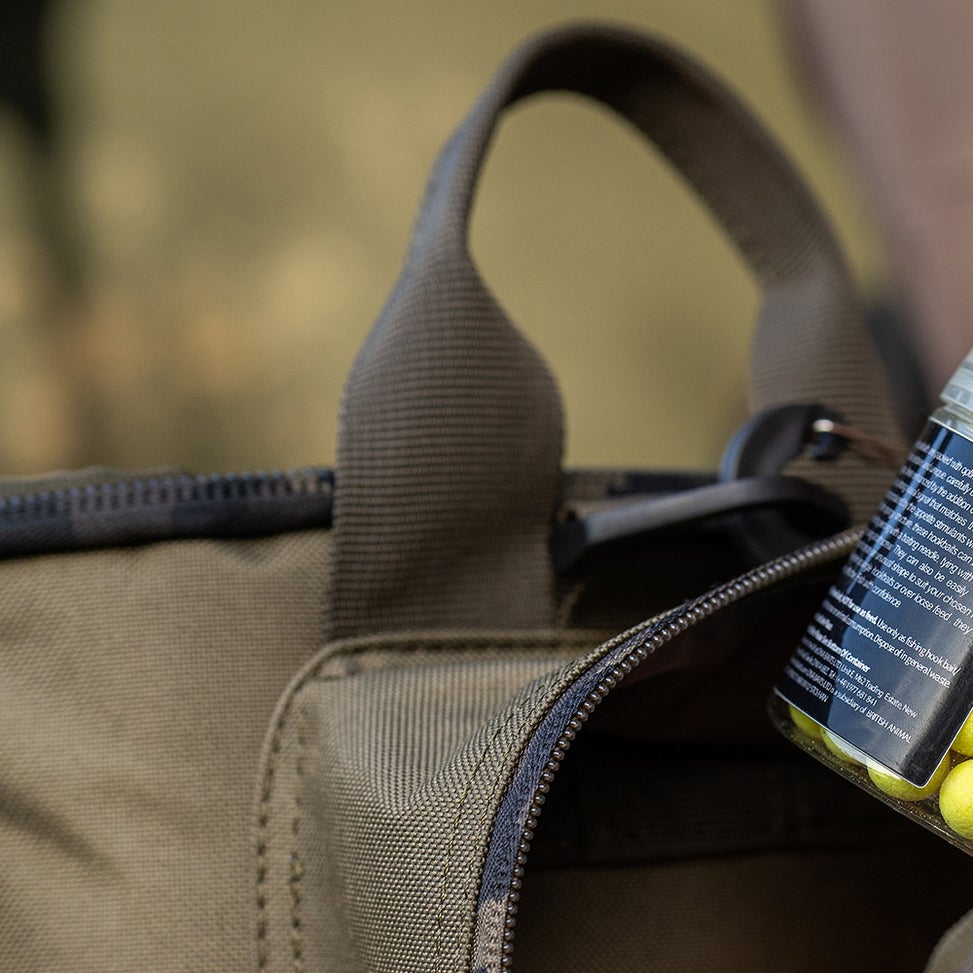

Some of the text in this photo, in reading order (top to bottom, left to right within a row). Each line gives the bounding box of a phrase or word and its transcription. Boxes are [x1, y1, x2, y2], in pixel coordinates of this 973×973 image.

[936, 485, 949, 498] the
[945, 489, 973, 512] addition
[944, 472, 973, 496] carefully
[912, 506, 936, 527] appetite
[933, 517, 968, 544] stimulants
[928, 497, 942, 511] that
[938, 503, 968, 526] matches
[899, 532, 921, 552] baiting
[925, 530, 959, 556] hookbaits
[956, 549, 973, 564] can
[890, 544, 908, 561] They
[905, 554, 919, 567] can
[917, 560, 935, 576] also
[933, 569, 946, 583] be
[943, 576, 970, 599] easily
[890, 561, 911, 580] shape
[907, 571, 918, 583] to
[913, 575, 929, 590] suit
[924, 584, 945, 602] your
[941, 592, 972, 616] chosen
[870, 583, 903, 608] confidence
[892, 581, 901, 590] or
[898, 585, 916, 600] over
[912, 592, 935, 611] loose
[951, 616, 973, 637] they
[839, 647, 849, 658] Of
[844, 651, 872, 673] Container
[863, 610, 880, 625] feed.
[875, 618, 889, 631] Use
[884, 624, 901, 640] only
[897, 633, 907, 643] as
[902, 635, 928, 658] fishing
[924, 648, 945, 666] hook
[940, 659, 961, 677] bait/
[871, 633, 897, 655] Dispose
[893, 646, 904, 657] of
[899, 650, 909, 661] in
[904, 654, 932, 677] general
[927, 670, 952, 689] waste.
[839, 663, 852, 676] Unit
[852, 672, 867, 686] M62
[862, 679, 885, 699] Trading
[901, 703, 919, 719] New
[865, 695, 877, 706] 841
[834, 689, 862, 712] subsidiary
[858, 704, 867, 714] of
[864, 709, 889, 728] BRITISH
[885, 722, 914, 744] ANIMAL
